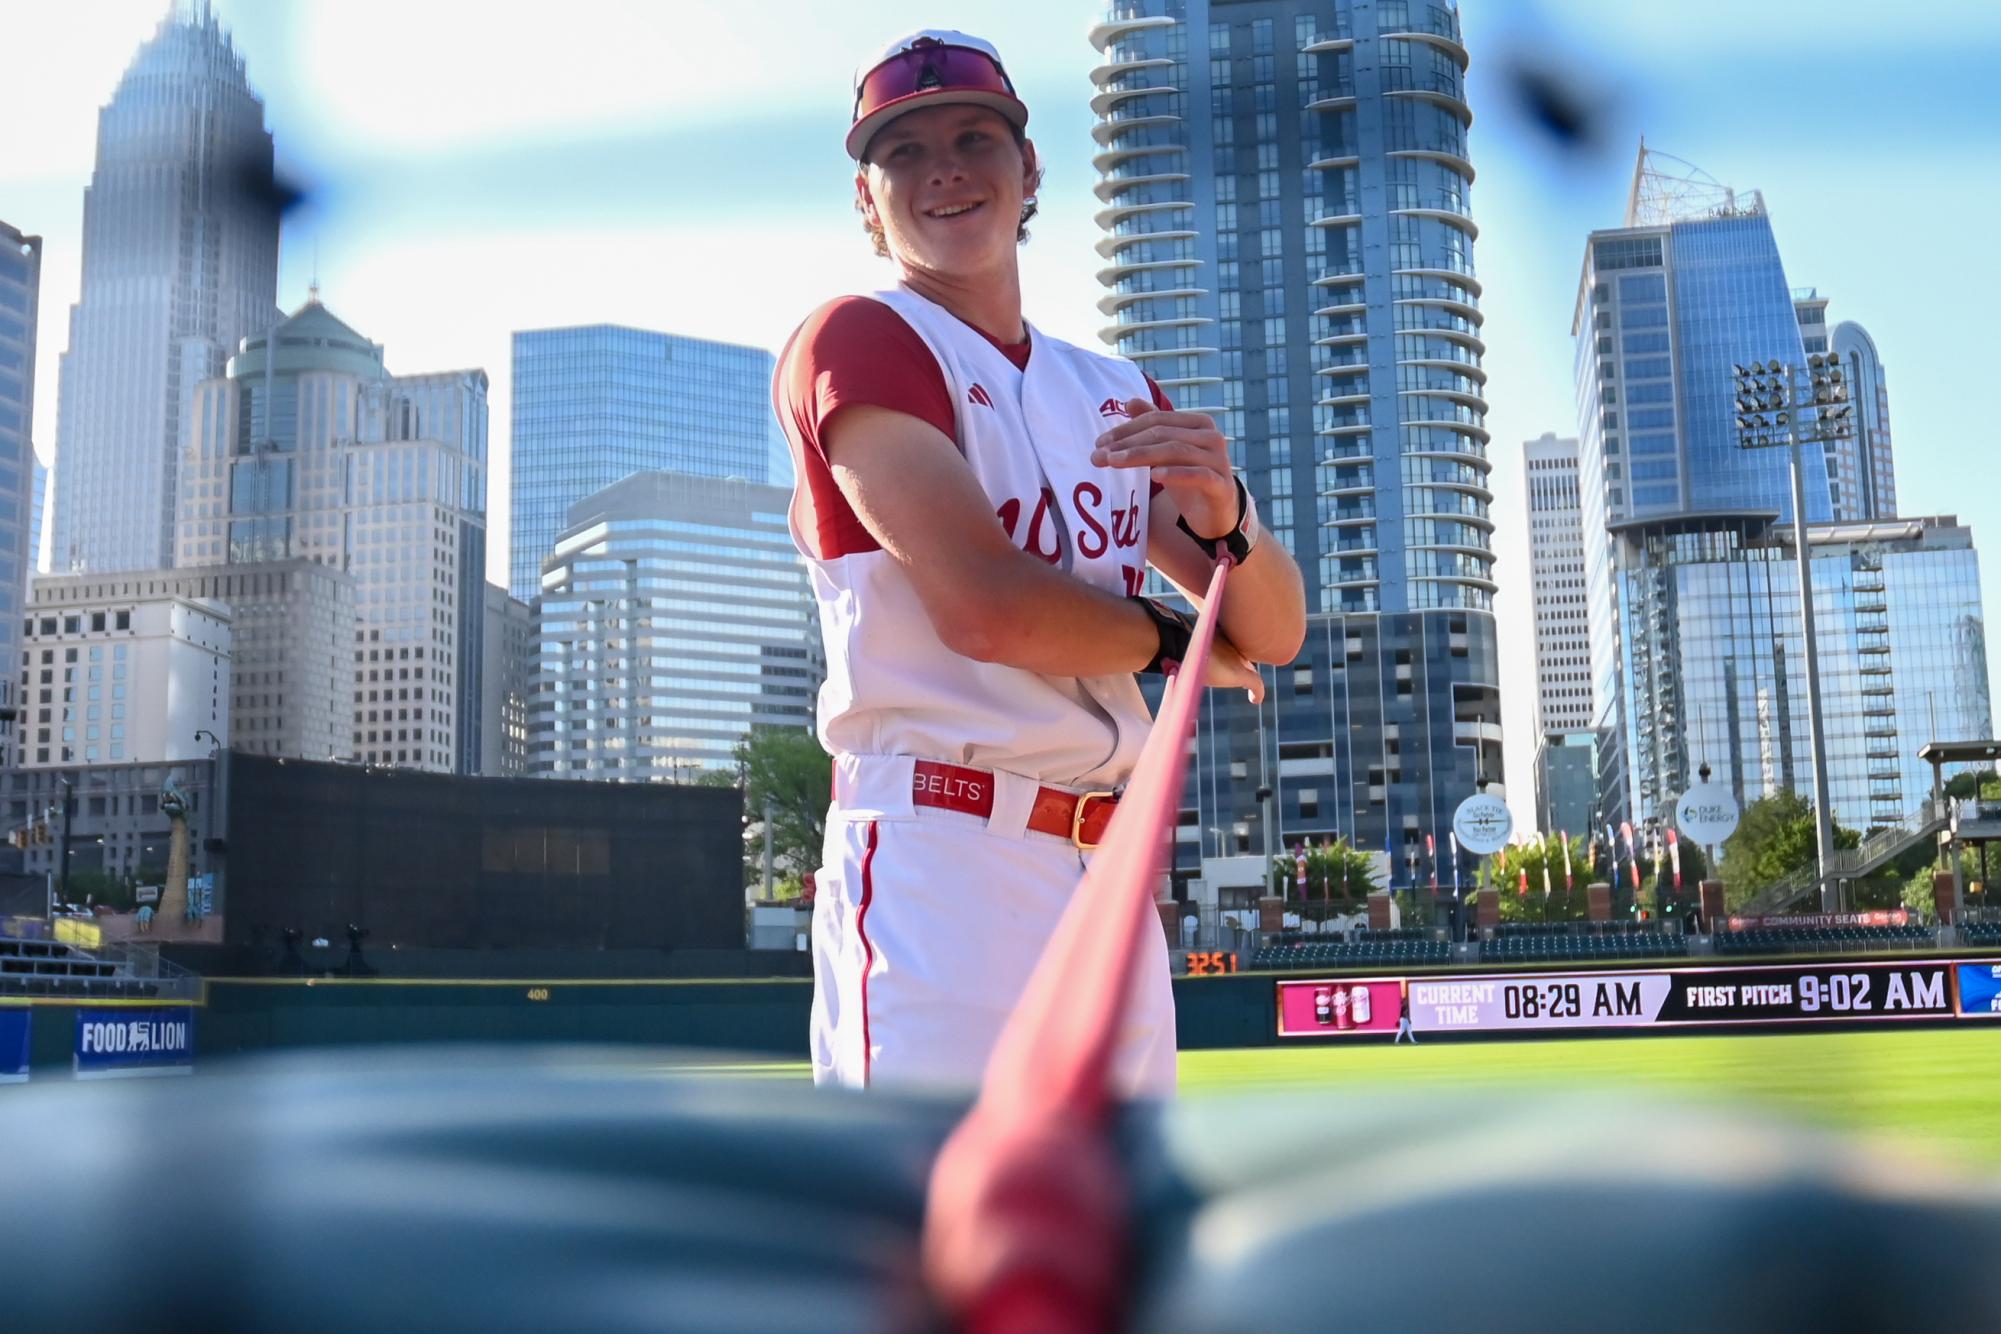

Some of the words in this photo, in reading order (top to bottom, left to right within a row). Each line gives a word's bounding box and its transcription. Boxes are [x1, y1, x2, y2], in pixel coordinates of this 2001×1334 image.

[913, 773, 981, 800] BELTS
[1699, 805, 1721, 813] DUKE
[1699, 814, 1735, 823] ENERGY
[1763, 915, 1832, 926] COMMUNITY
[1835, 913, 1871, 924] SEATS
[527, 988, 548, 1000] 400
[1416, 983, 1496, 1005] CURRENT
[1504, 983, 1581, 1019] 08:29
[1592, 981, 1644, 1016] AM
[1686, 986, 1736, 1007] FIRST
[1741, 984, 1793, 1006] PITCH
[1799, 974, 1872, 1012] 9:02
[1884, 971, 1946, 1010] AM
[1435, 1005, 1479, 1025] TIME
[82, 1023, 127, 1052] FOOD
[151, 1022, 186, 1050] LION
